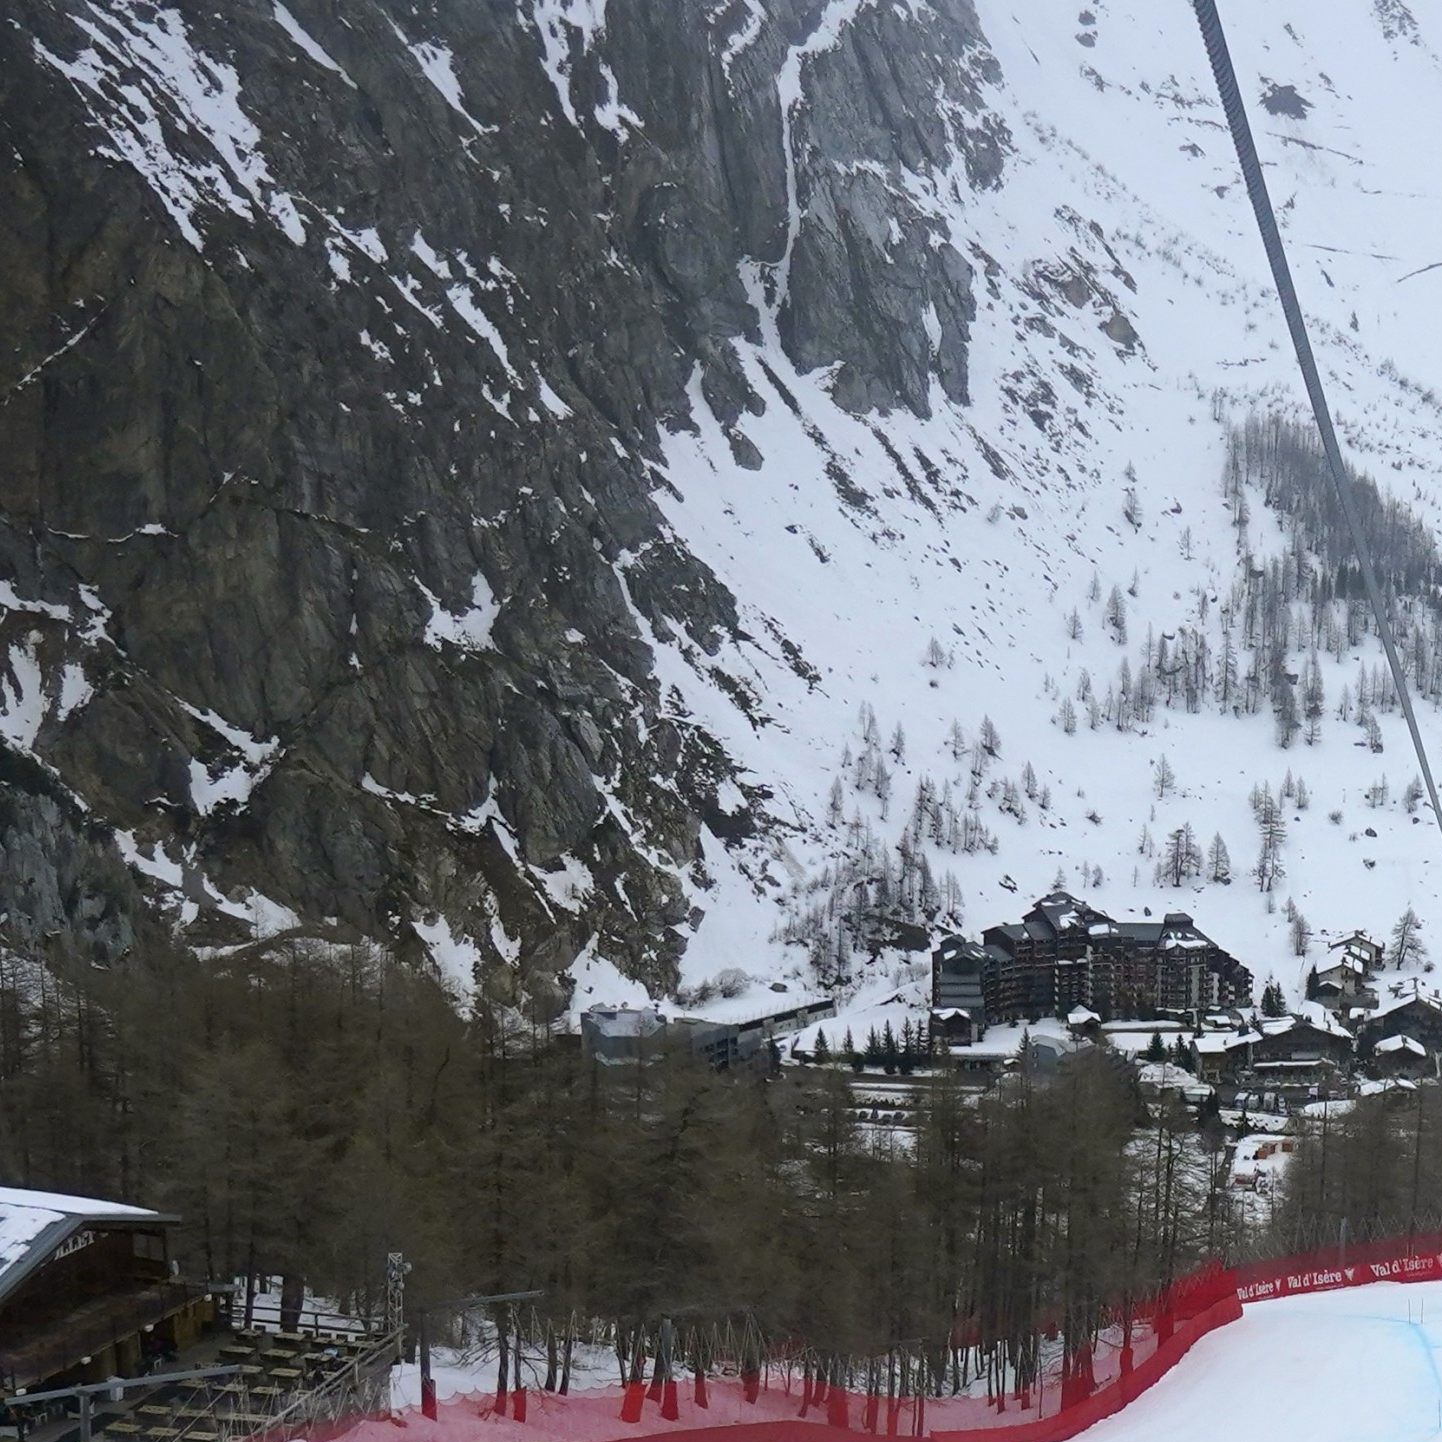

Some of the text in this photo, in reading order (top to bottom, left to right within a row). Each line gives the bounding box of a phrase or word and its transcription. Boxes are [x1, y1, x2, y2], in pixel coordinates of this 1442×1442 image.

[1370, 1256, 1434, 1277] Val d'Isère
[1287, 1269, 1342, 1289] Val d'Isère
[1237, 1281, 1274, 1300] Val d'Isère
